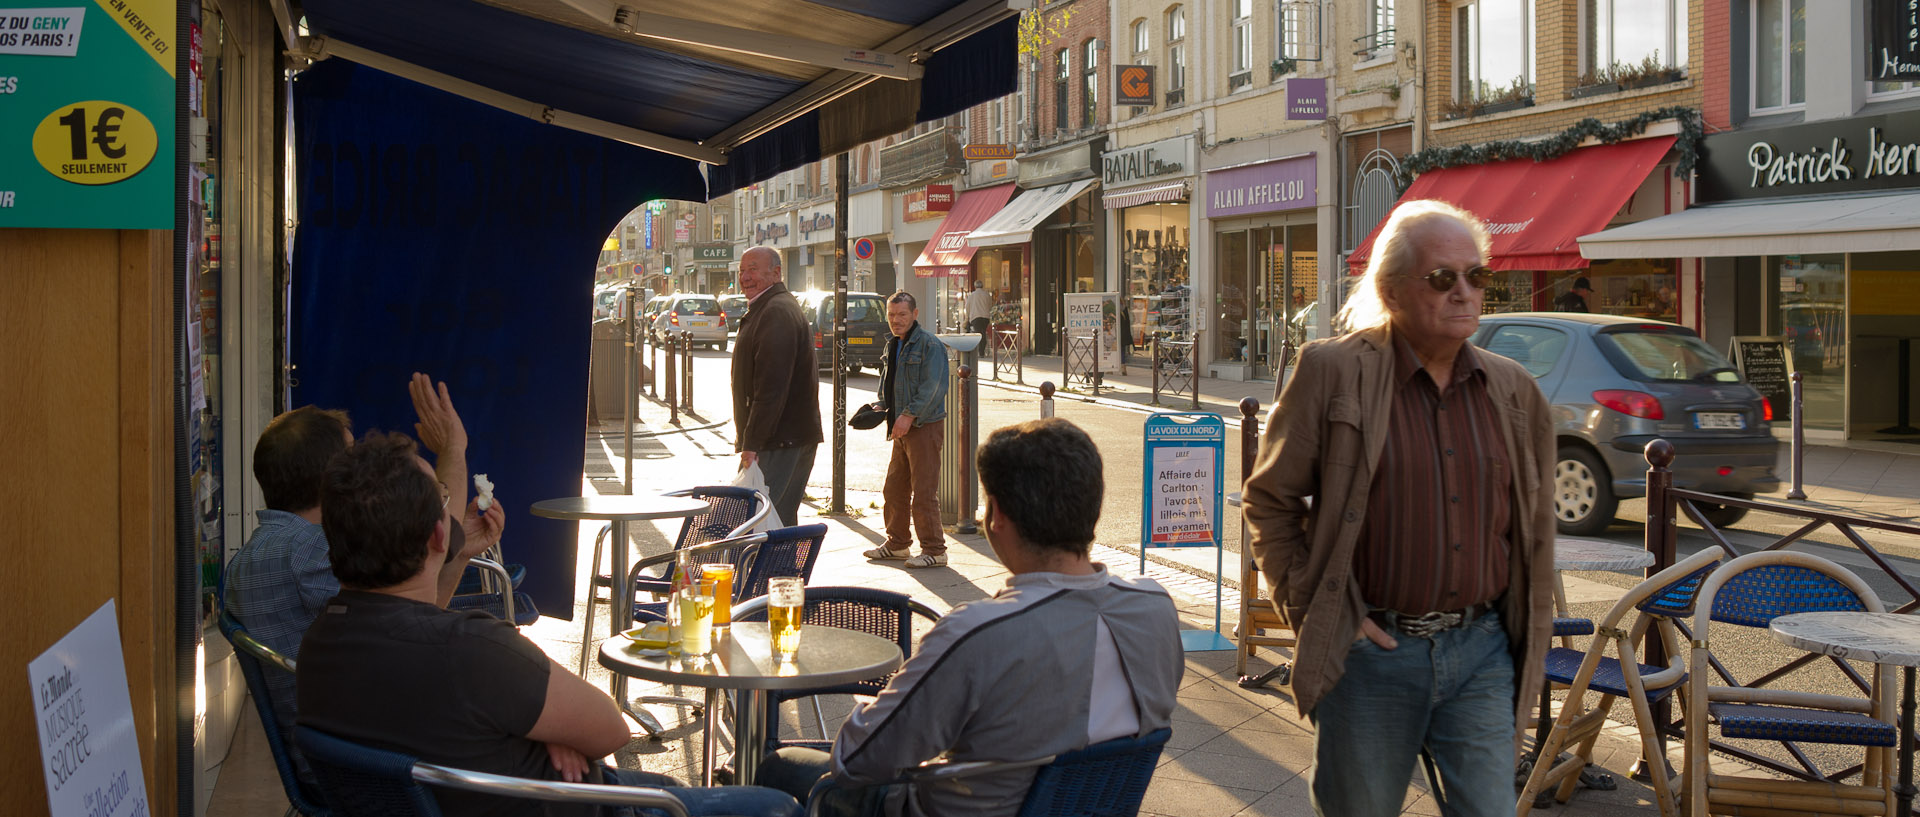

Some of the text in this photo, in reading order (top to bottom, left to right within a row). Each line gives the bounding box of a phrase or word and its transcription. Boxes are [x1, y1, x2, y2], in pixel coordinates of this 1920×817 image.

[9, 16, 29, 30] DU
[32, 17, 70, 30] GENY
[109, 0, 169, 55] EN VENTE ICI
[0, 33, 73, 46] OS PARIS !
[59, 107, 127, 160] 1€
[970, 147, 1011, 156] NICOLAS
[1104, 147, 1155, 184] BATALIE
[1748, 137, 1850, 188] Patrick
[62, 163, 127, 175] SEULEMENT
[1213, 179, 1304, 209] ALAIN AFFLELOU
[1070, 304, 1101, 314] PAYEZ
[1070, 320, 1082, 328] EN
[1090, 319, 1101, 327] AN
[1150, 426, 1215, 435] LA VOIX DU NORD
[1159, 469, 1207, 480] Affaire du
[1161, 484, 1198, 493] Carlton
[1164, 496, 1203, 506] l'avocat
[1160, 509, 1207, 520] lillois mis
[1157, 523, 1210, 533] en examen
[47, 665, 72, 704] Monde
[45, 687, 85, 748] MUSIQUE
[51, 721, 91, 791] sacrée
